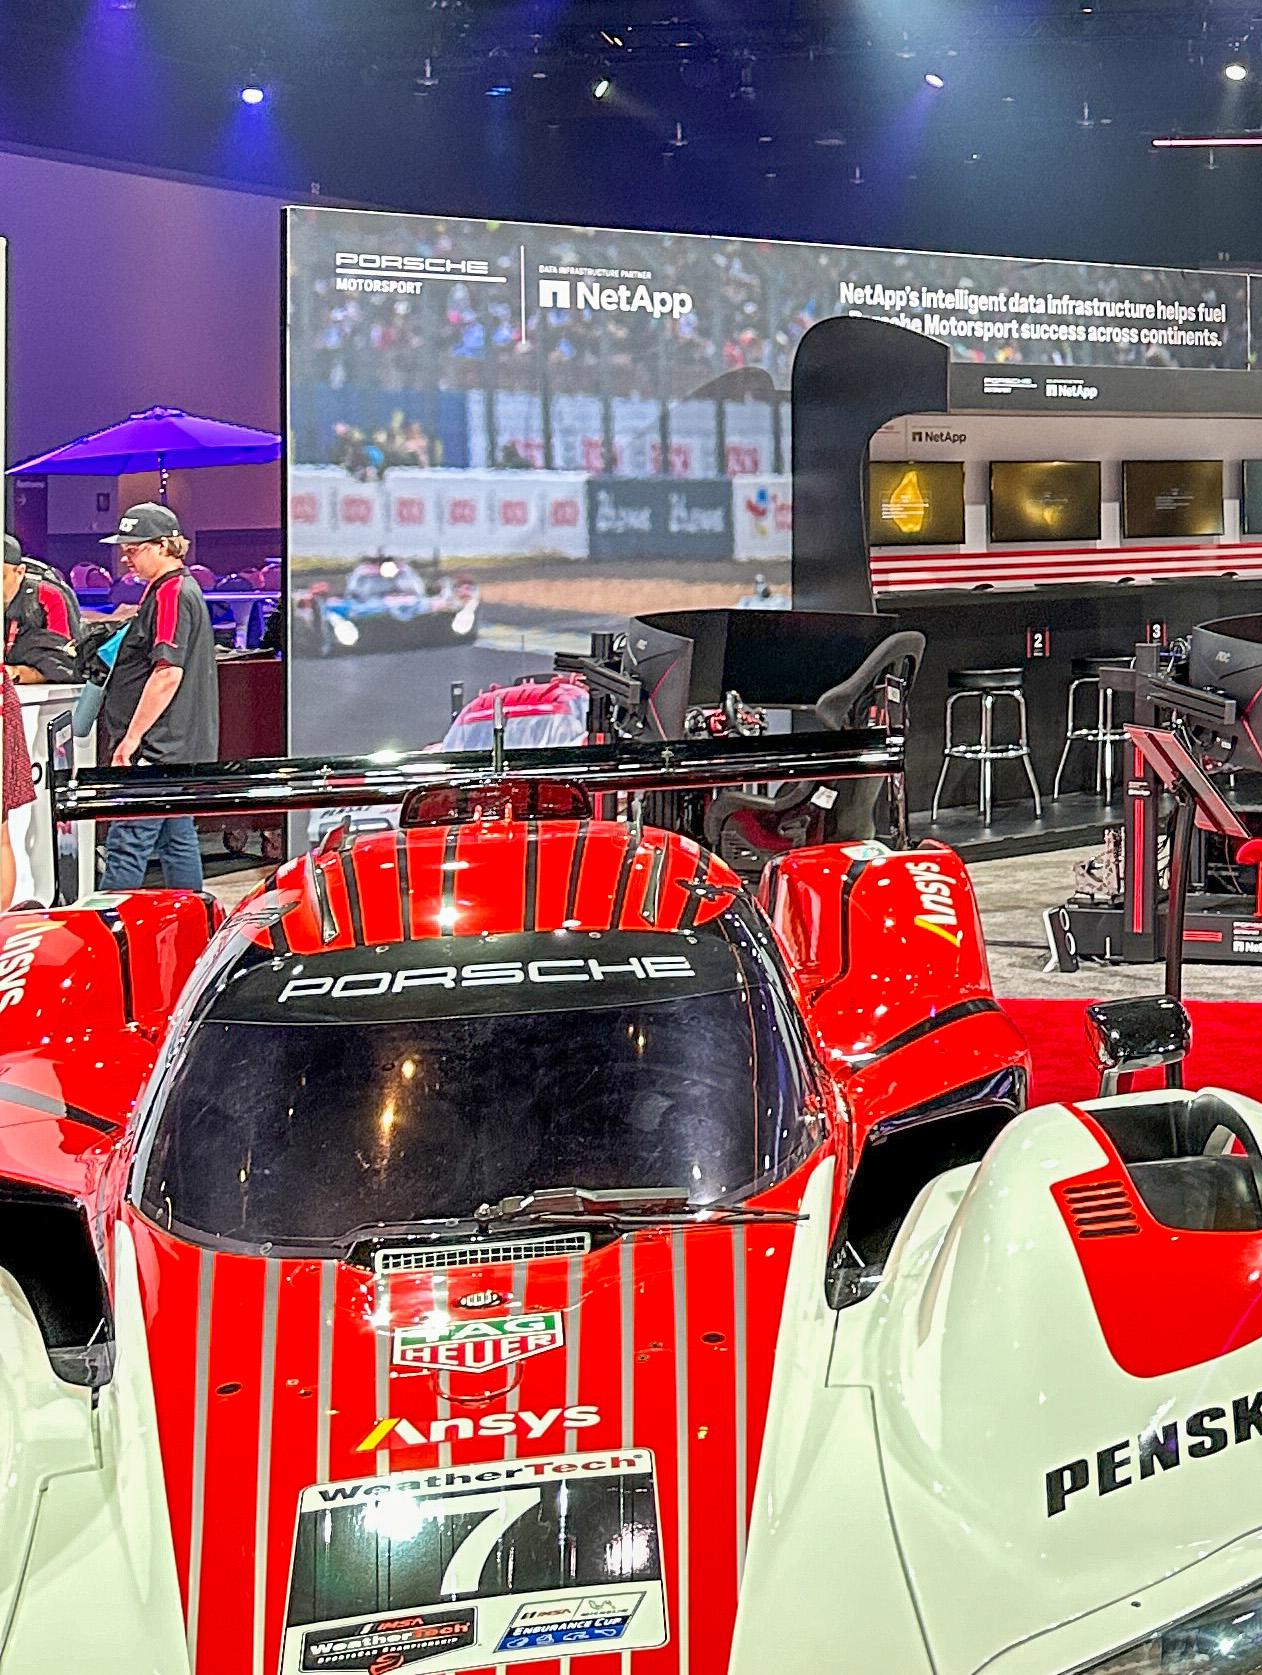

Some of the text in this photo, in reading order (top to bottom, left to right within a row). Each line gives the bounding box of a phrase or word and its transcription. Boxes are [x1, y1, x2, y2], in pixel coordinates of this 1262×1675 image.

[335, 252, 489, 275] PORSCHE
[335, 278, 423, 295] MOTORSPORT
[576, 281, 693, 319] NetApp
[839, 281, 1226, 324] NetApp's intelligent data infrastructure helps fuel
[924, 313, 1019, 342] Motorsport
[1019, 322, 1086, 341] success
[1087, 325, 1139, 343] across
[1140, 325, 1223, 347] continents.
[1058, 384, 1098, 400] NetApp
[925, 431, 967, 444] NetApp
[1034, 633, 1043, 648] 2
[1152, 622, 1161, 638] 3
[904, 861, 960, 948] Ansys
[278, 955, 696, 1003] PORSCHE
[416, 1314, 545, 1343] TAG
[405, 1334, 552, 1367] HEUER
[355, 1404, 601, 1452] Ansys
[408, 1487, 542, 1597] 7
